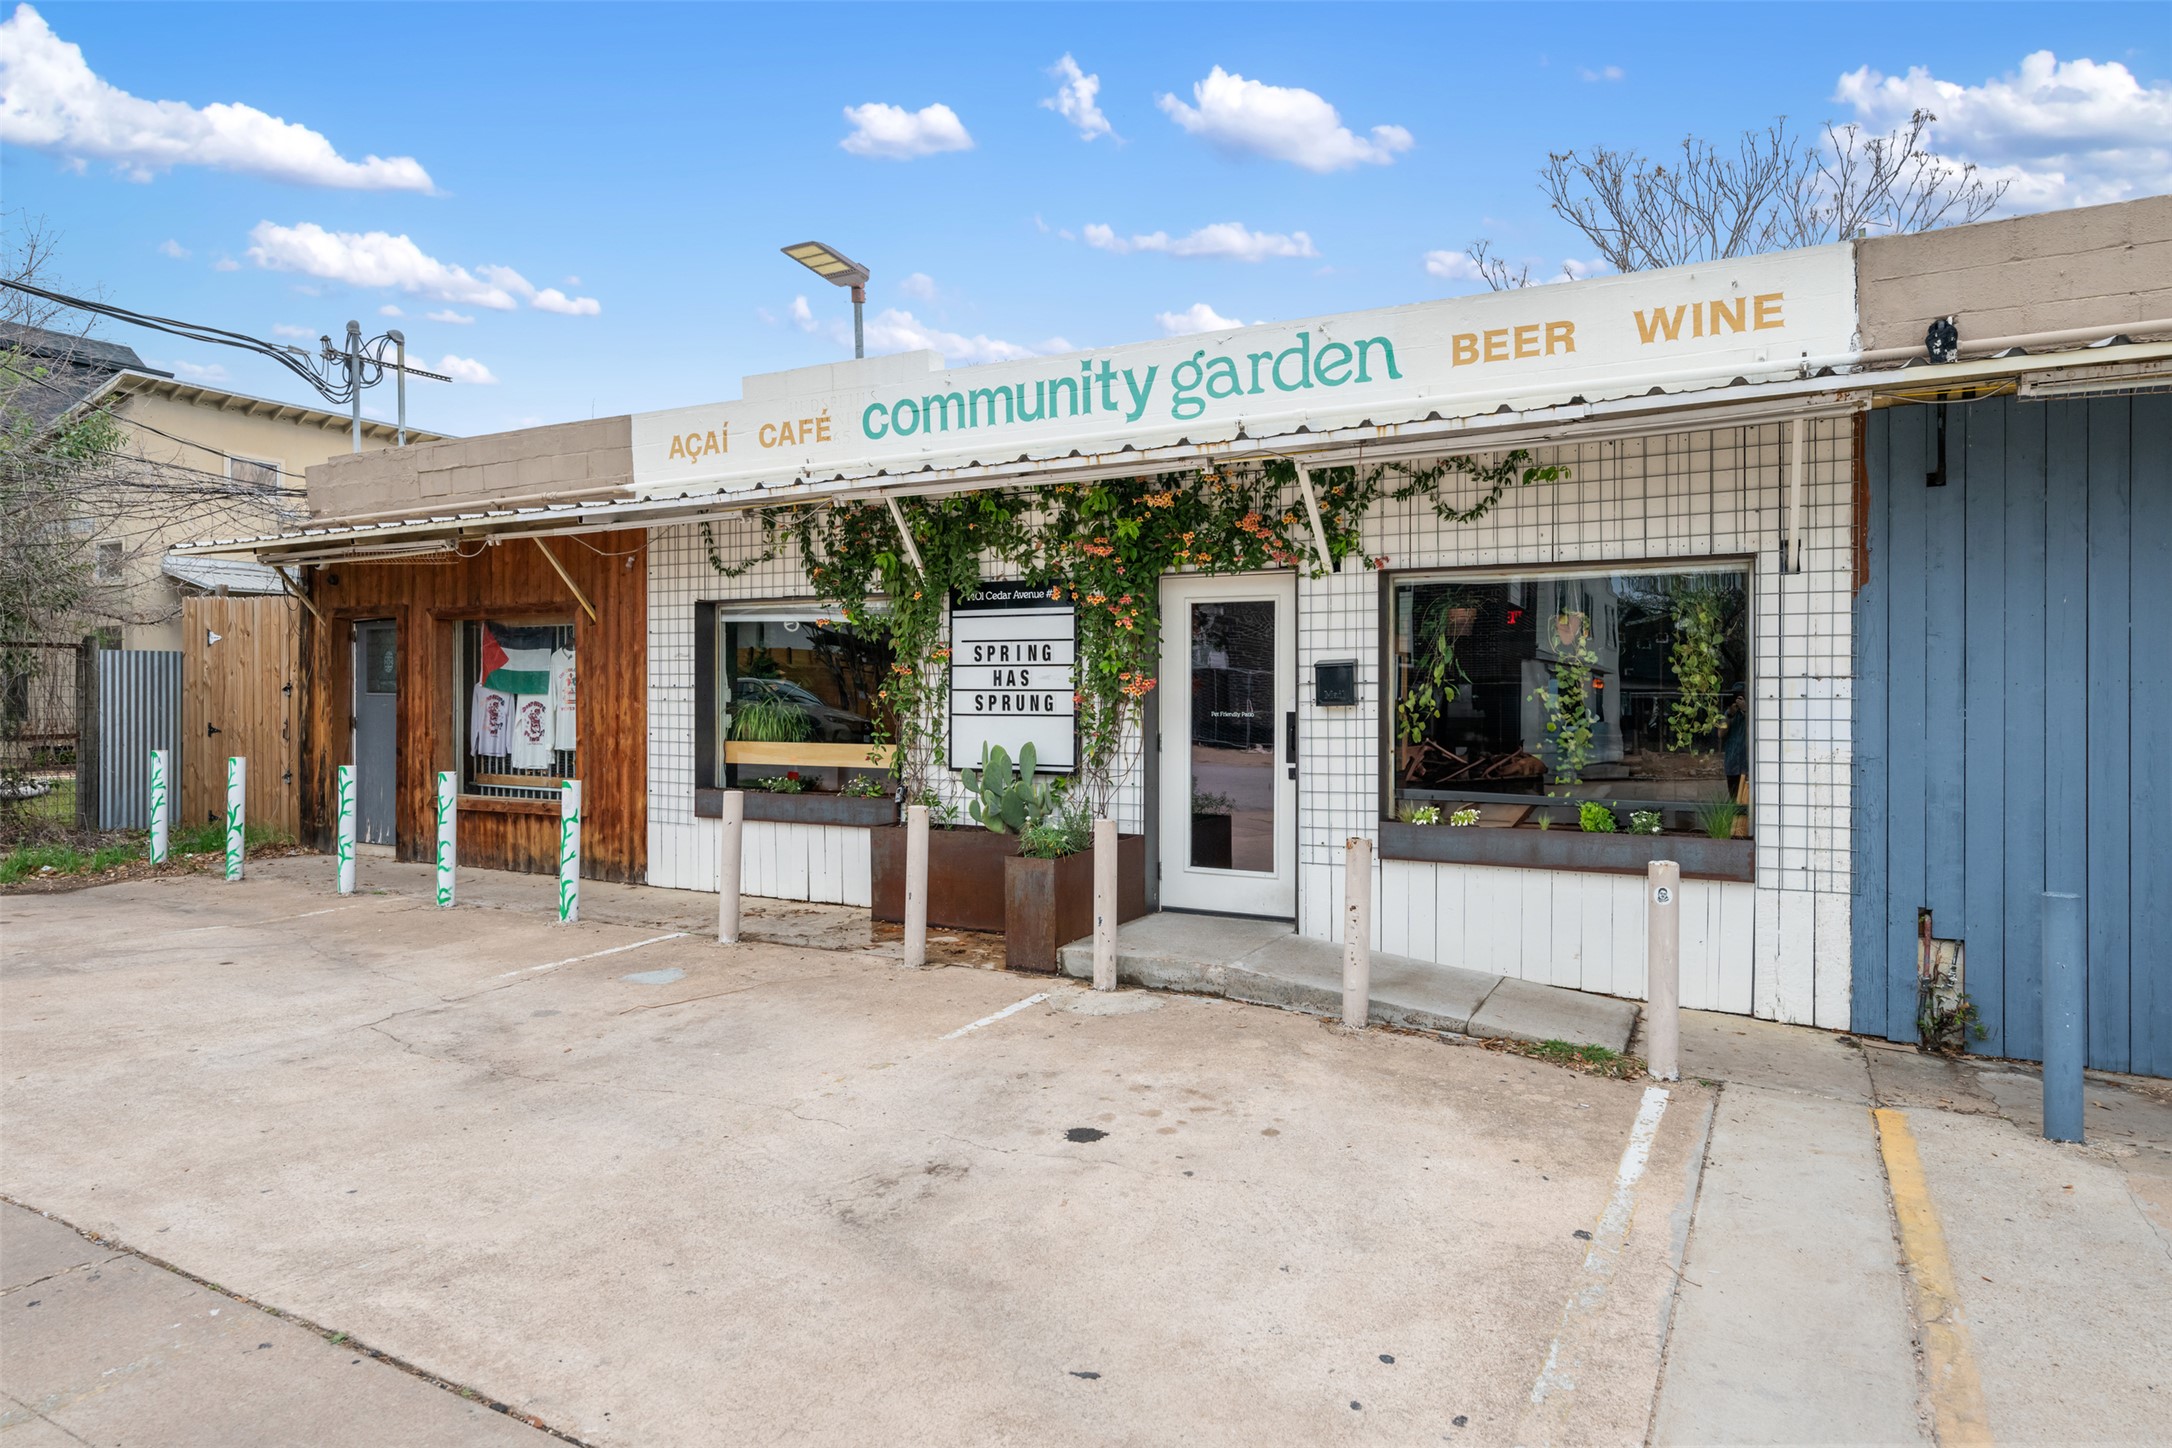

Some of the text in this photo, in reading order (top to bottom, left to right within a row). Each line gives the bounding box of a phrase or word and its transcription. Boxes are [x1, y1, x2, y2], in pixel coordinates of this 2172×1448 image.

[1451, 291, 1786, 368] BEER WINE
[862, 331, 1403, 440] community garden
[668, 421, 729, 464] AÇAÍ
[758, 408, 832, 449] CAFÉ
[967, 591, 984, 601] 401
[985, 591, 1012, 600] Cedar
[1013, 590, 1045, 600] Avenue
[974, 644, 1052, 662] SPRING
[993, 669, 1030, 687] HAS
[974, 694, 1054, 712] SPRUNG
